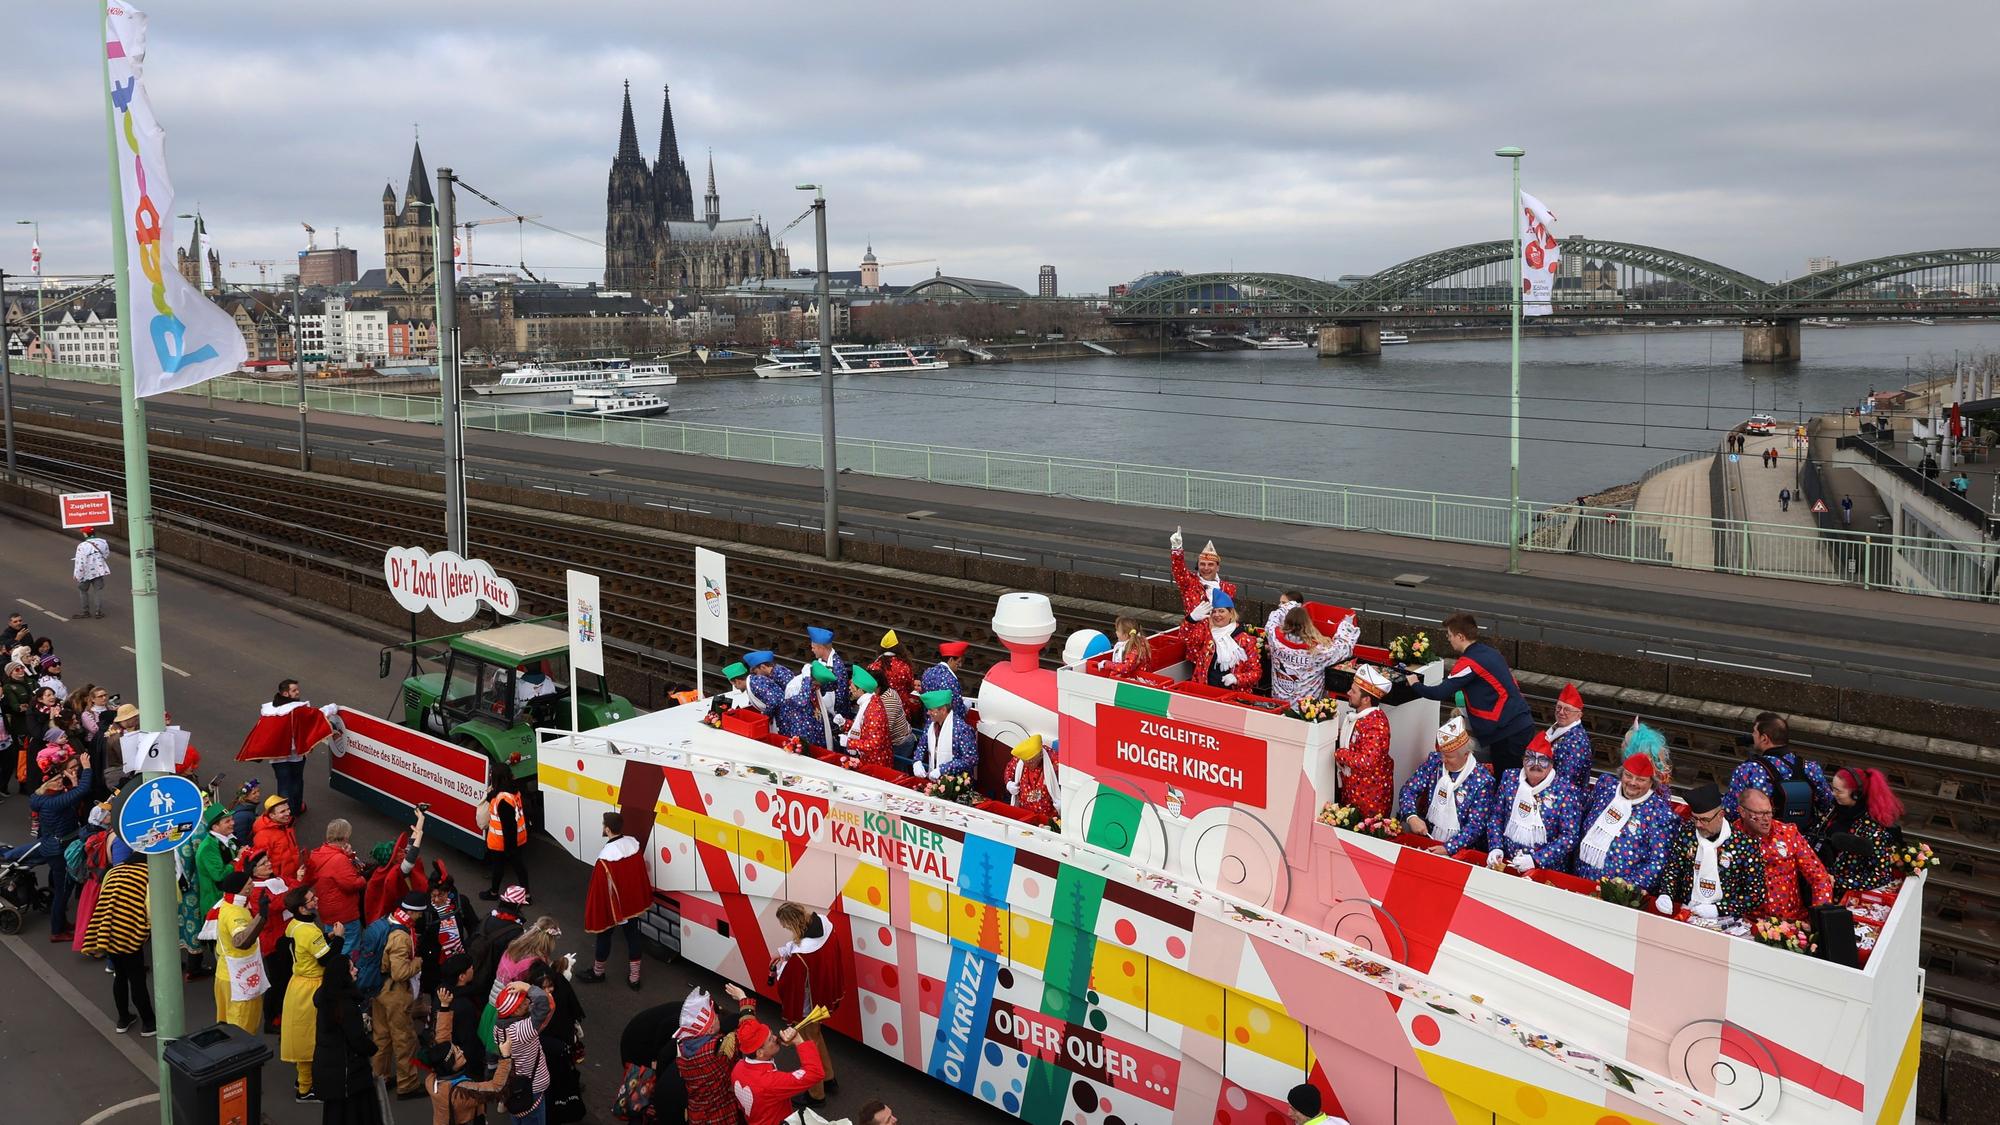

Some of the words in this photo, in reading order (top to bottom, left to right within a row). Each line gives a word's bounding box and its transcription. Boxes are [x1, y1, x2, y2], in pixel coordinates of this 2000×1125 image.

[390, 557, 408, 591] D'r
[411, 559, 438, 599] Zoch
[441, 561, 479, 607] (leiter)
[483, 576, 509, 608] kütt
[148, 743, 160, 759] 6
[521, 735, 533, 745] 56
[1140, 720, 1220, 751] ZUGLEITER:
[346, 737, 380, 758] Festkomitee
[380, 750, 391, 762] des
[391, 754, 412, 772] Kölner
[412, 762, 443, 784] Karnevals
[443, 779, 456, 789] von
[456, 781, 473, 798] 1823
[1117, 740, 1179, 773] HOLGER
[1182, 756, 1243, 790] KIRSCH
[771, 795, 825, 843] 200
[827, 808, 860, 828] JAHRE
[863, 810, 945, 854] KÖLNER
[831, 820, 955, 883] KARNEVAL
[950, 951, 986, 1043] KRÜZZ
[944, 1040, 967, 1084] OV
[994, 1008, 1063, 1055] ODER
[1066, 1034, 1139, 1084] QUER
